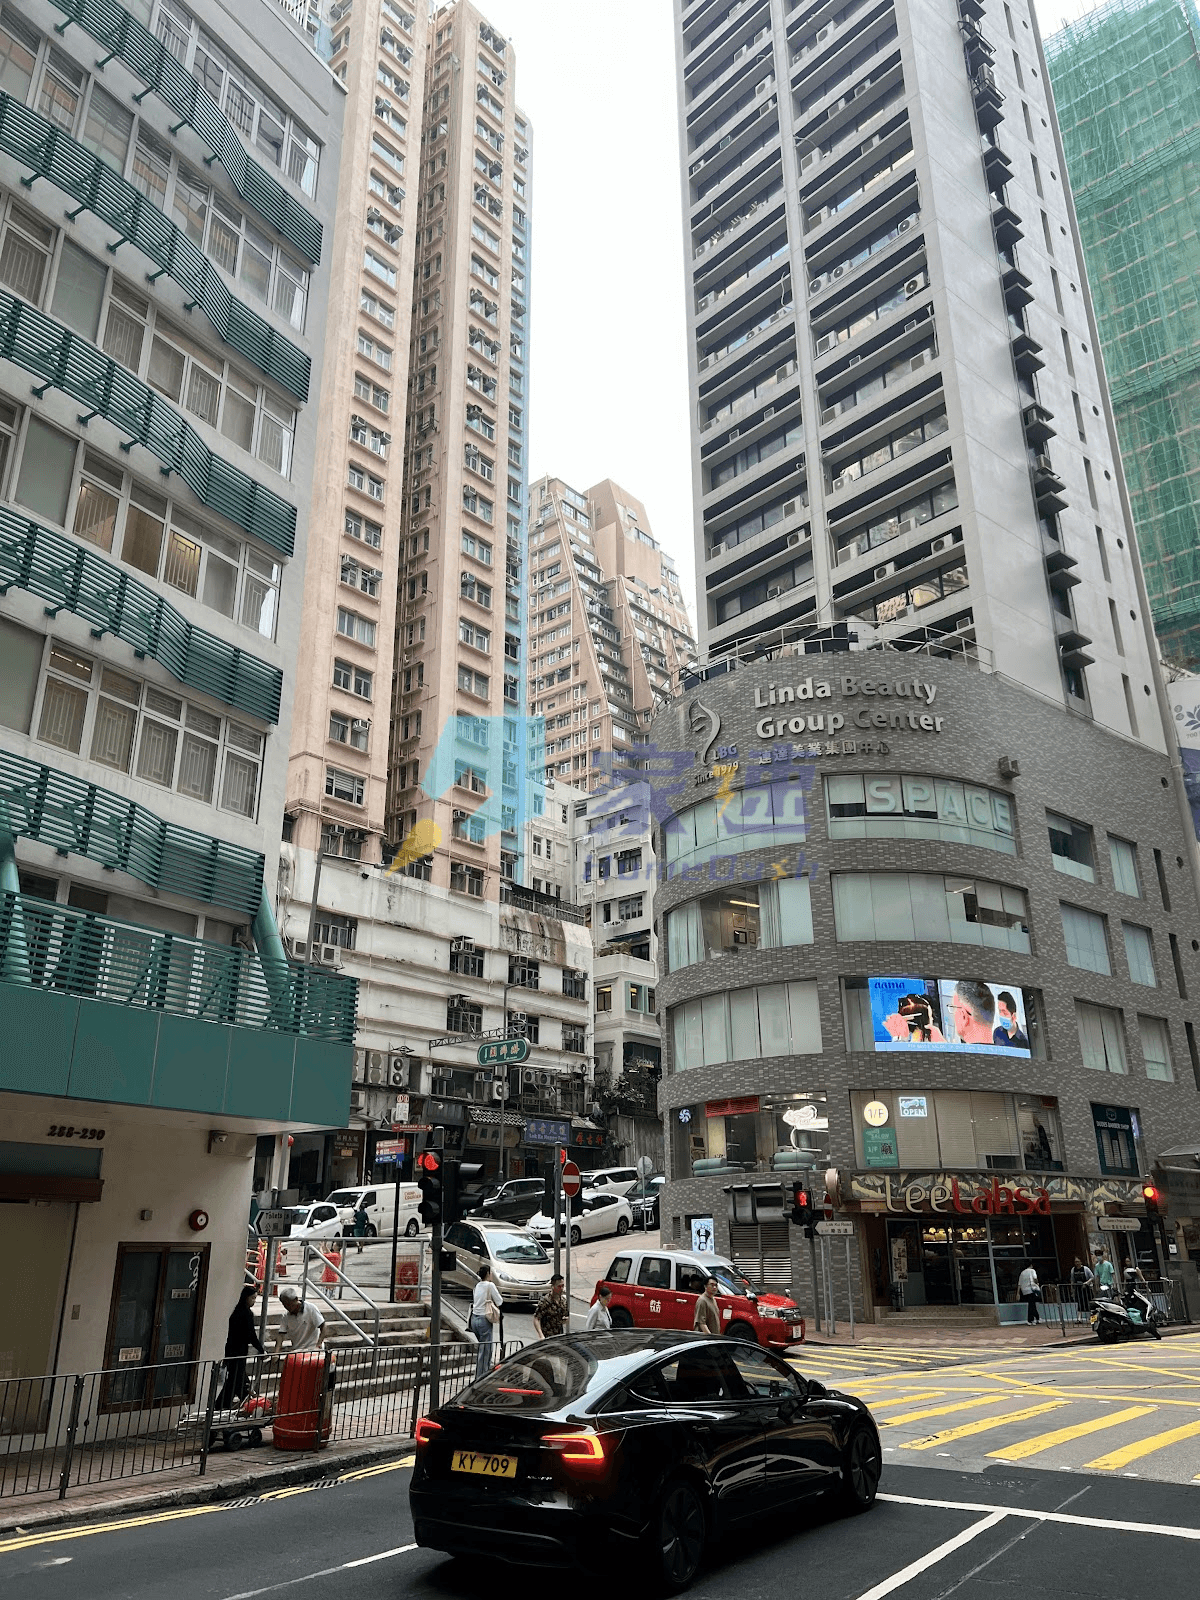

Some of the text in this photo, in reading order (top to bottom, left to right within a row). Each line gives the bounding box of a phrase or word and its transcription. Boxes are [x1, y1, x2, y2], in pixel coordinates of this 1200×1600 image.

[754, 676, 937, 708] Linda Beauty
[756, 709, 945, 739] Group Center
[711, 742, 738, 761] LBG
[716, 761, 739, 776] 1979
[868, 780, 1013, 836] SPACE
[867, 1108, 884, 1119] 1/F
[903, 1108, 924, 1116] OPEN
[47, 1125, 106, 1140] 288-290
[265, 1211, 282, 1219] Toilets
[458, 1453, 510, 1474] KY 709
